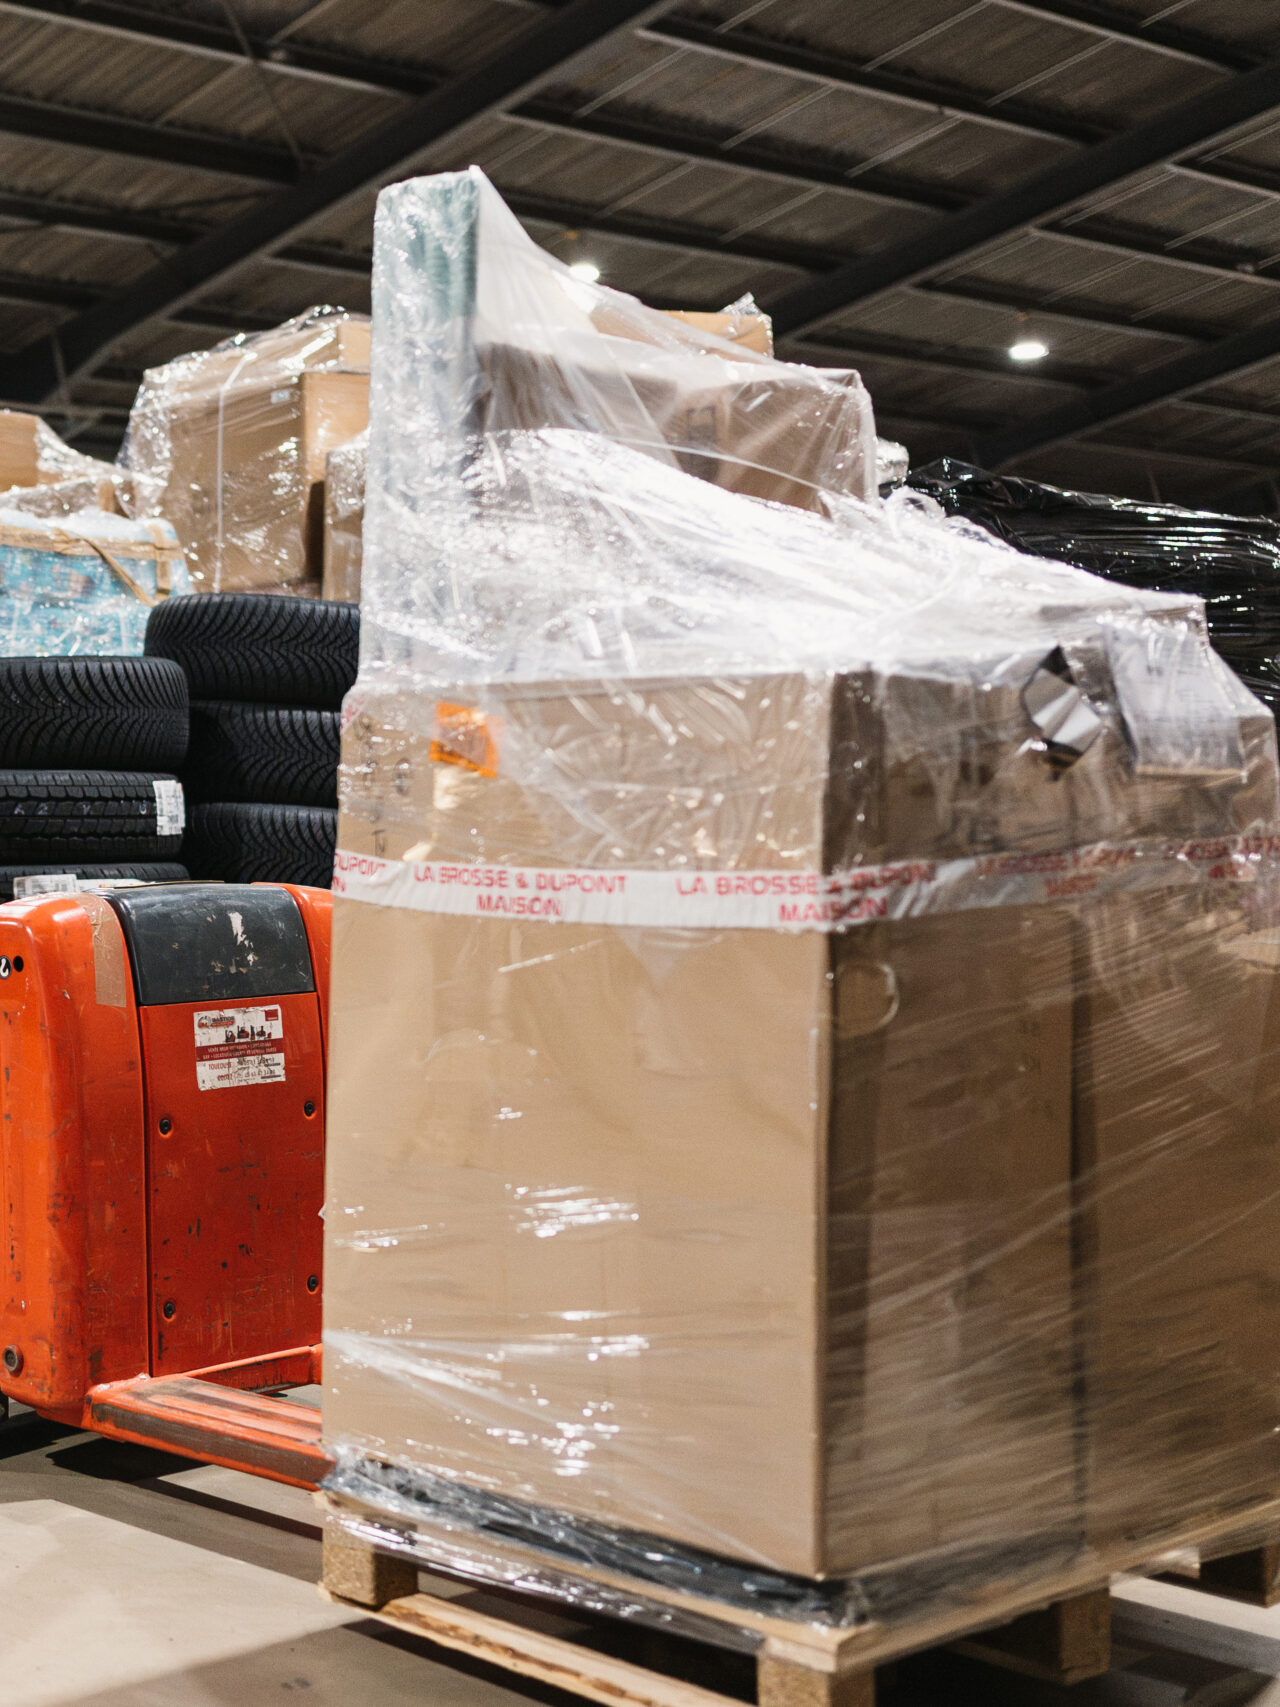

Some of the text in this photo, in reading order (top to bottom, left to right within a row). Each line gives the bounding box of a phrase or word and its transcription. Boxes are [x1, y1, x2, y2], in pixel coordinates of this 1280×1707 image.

[414, 865, 626, 894] LA BROSSE & DUPONT
[676, 876, 707, 896] LA
[715, 875, 819, 896] BROSSE
[477, 894, 561, 916] MAISON
[780, 896, 888, 922] MAISON
